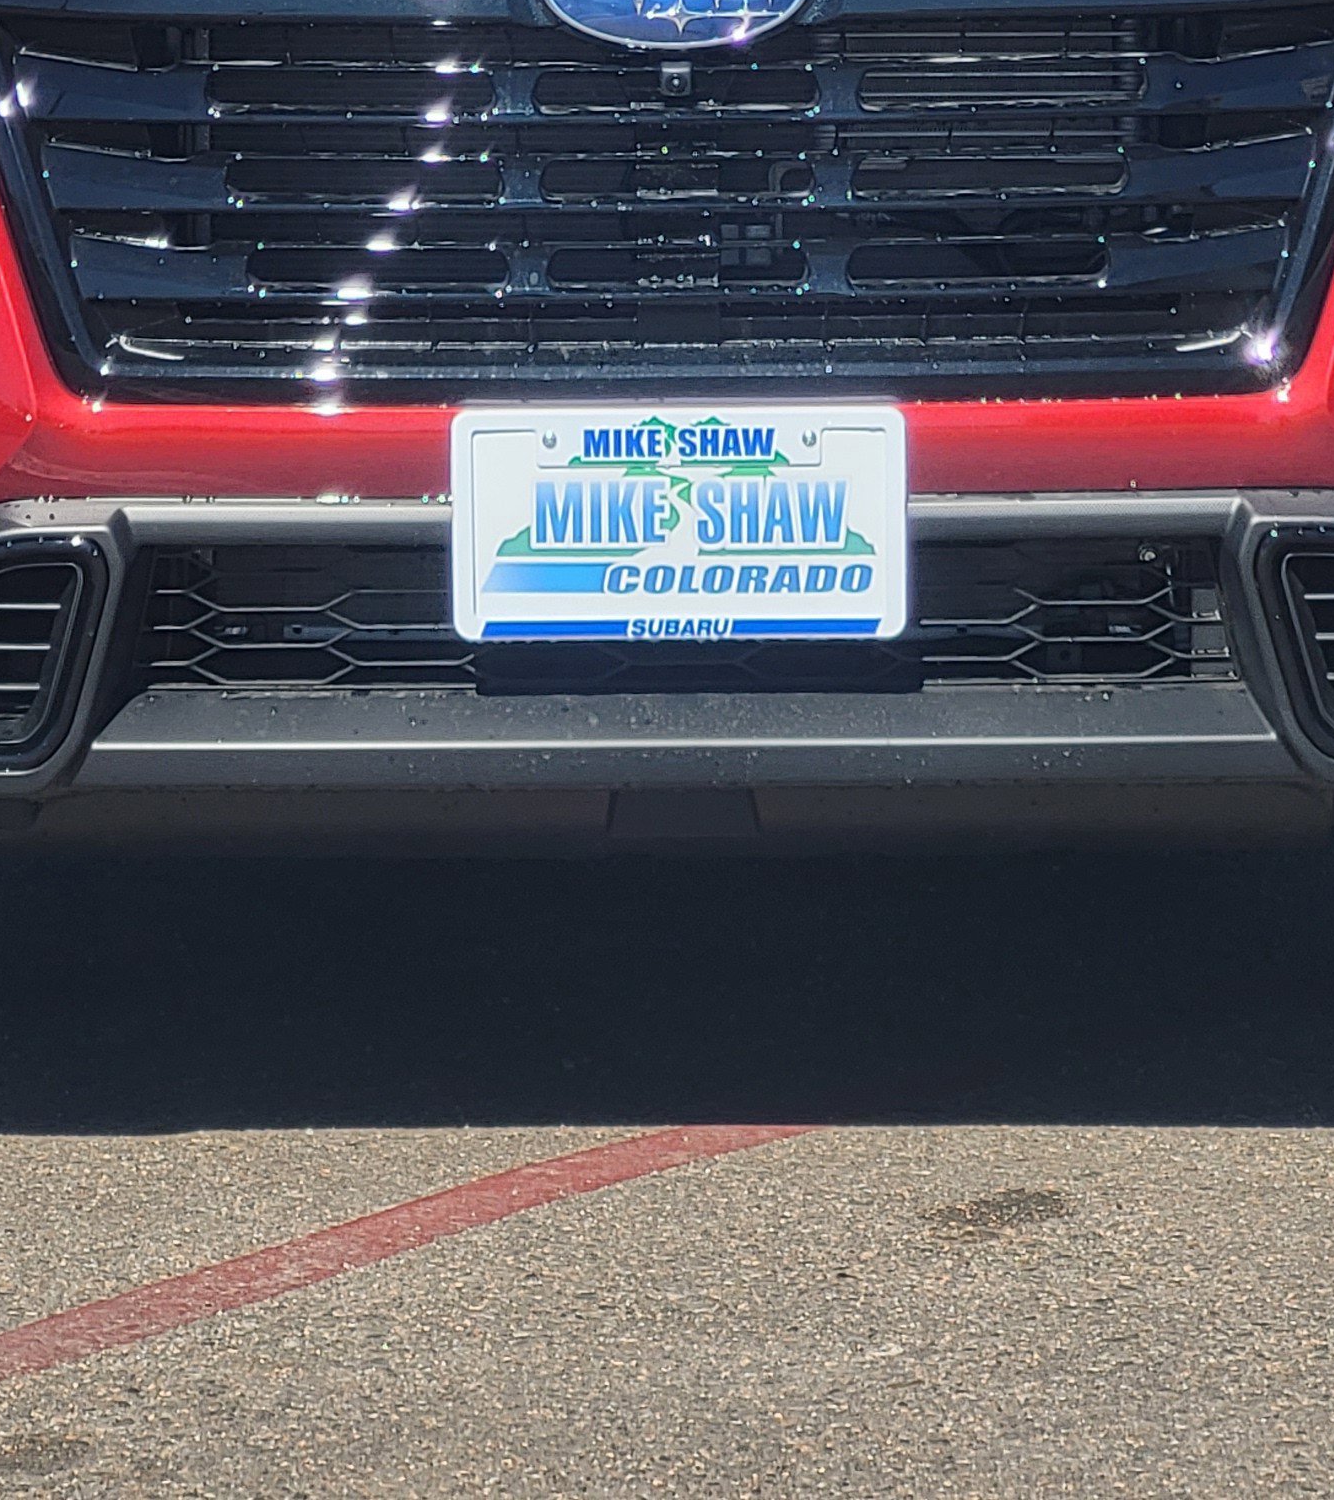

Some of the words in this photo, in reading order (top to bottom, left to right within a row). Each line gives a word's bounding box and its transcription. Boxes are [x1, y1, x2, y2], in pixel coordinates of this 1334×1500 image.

[583, 428, 664, 458] MIKE
[677, 427, 774, 457] SHAW
[534, 480, 667, 544] MIKE
[697, 480, 847, 545] SHAW
[607, 563, 874, 594] COLORADO
[630, 618, 730, 638] SUBARU
